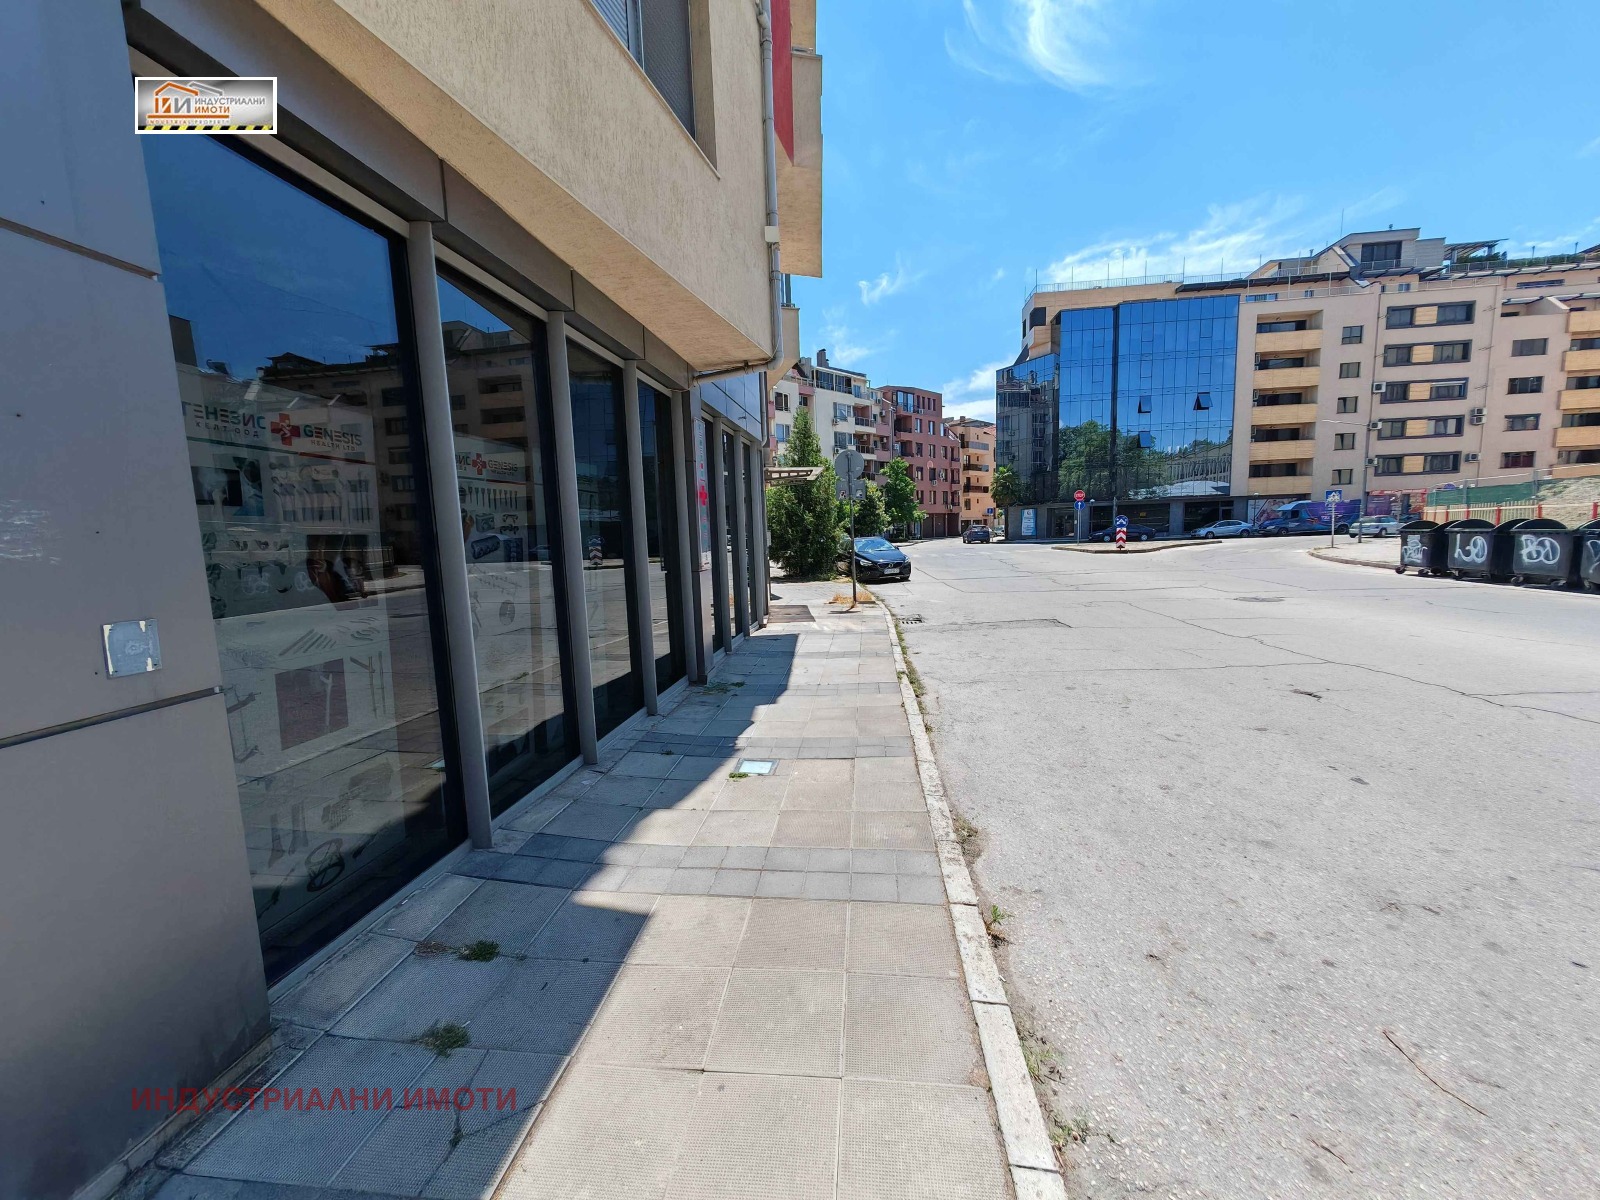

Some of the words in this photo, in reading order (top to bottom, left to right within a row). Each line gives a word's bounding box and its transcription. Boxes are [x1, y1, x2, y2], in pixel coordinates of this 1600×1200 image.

[303, 424, 363, 446] GENESIS
[310, 439, 340, 450] HEALTH
[487, 459, 518, 472] GENESIS
